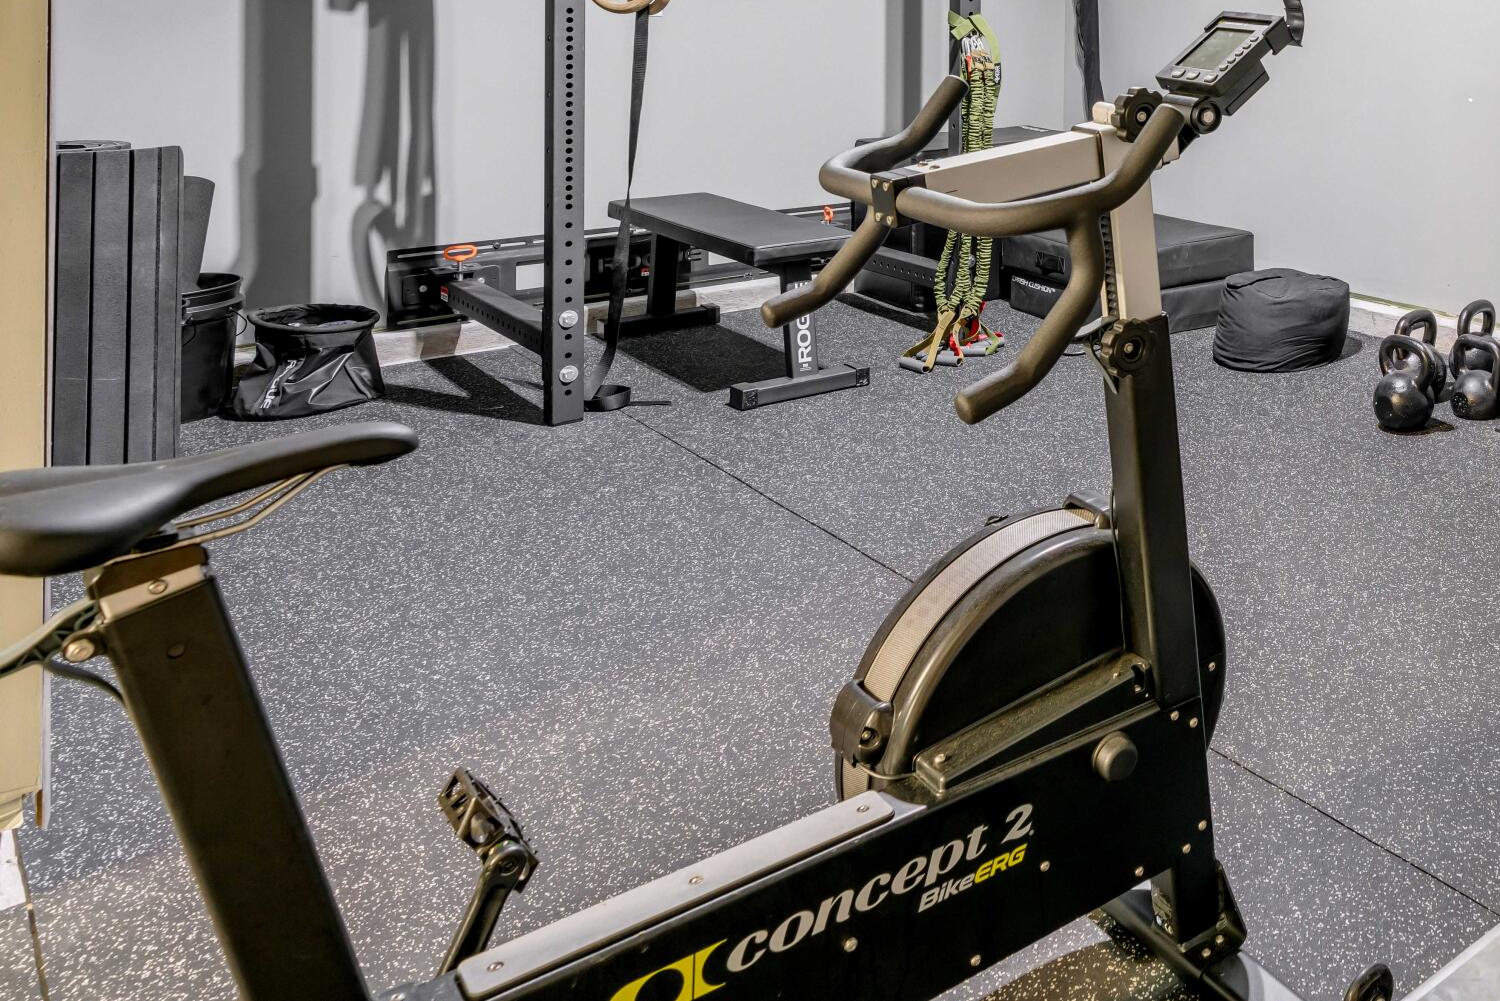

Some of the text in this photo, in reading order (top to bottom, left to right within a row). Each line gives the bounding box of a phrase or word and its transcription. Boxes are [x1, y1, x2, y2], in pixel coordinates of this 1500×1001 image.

[726, 803, 1035, 973] concept 2
[917, 843, 1028, 913] BikeERG
